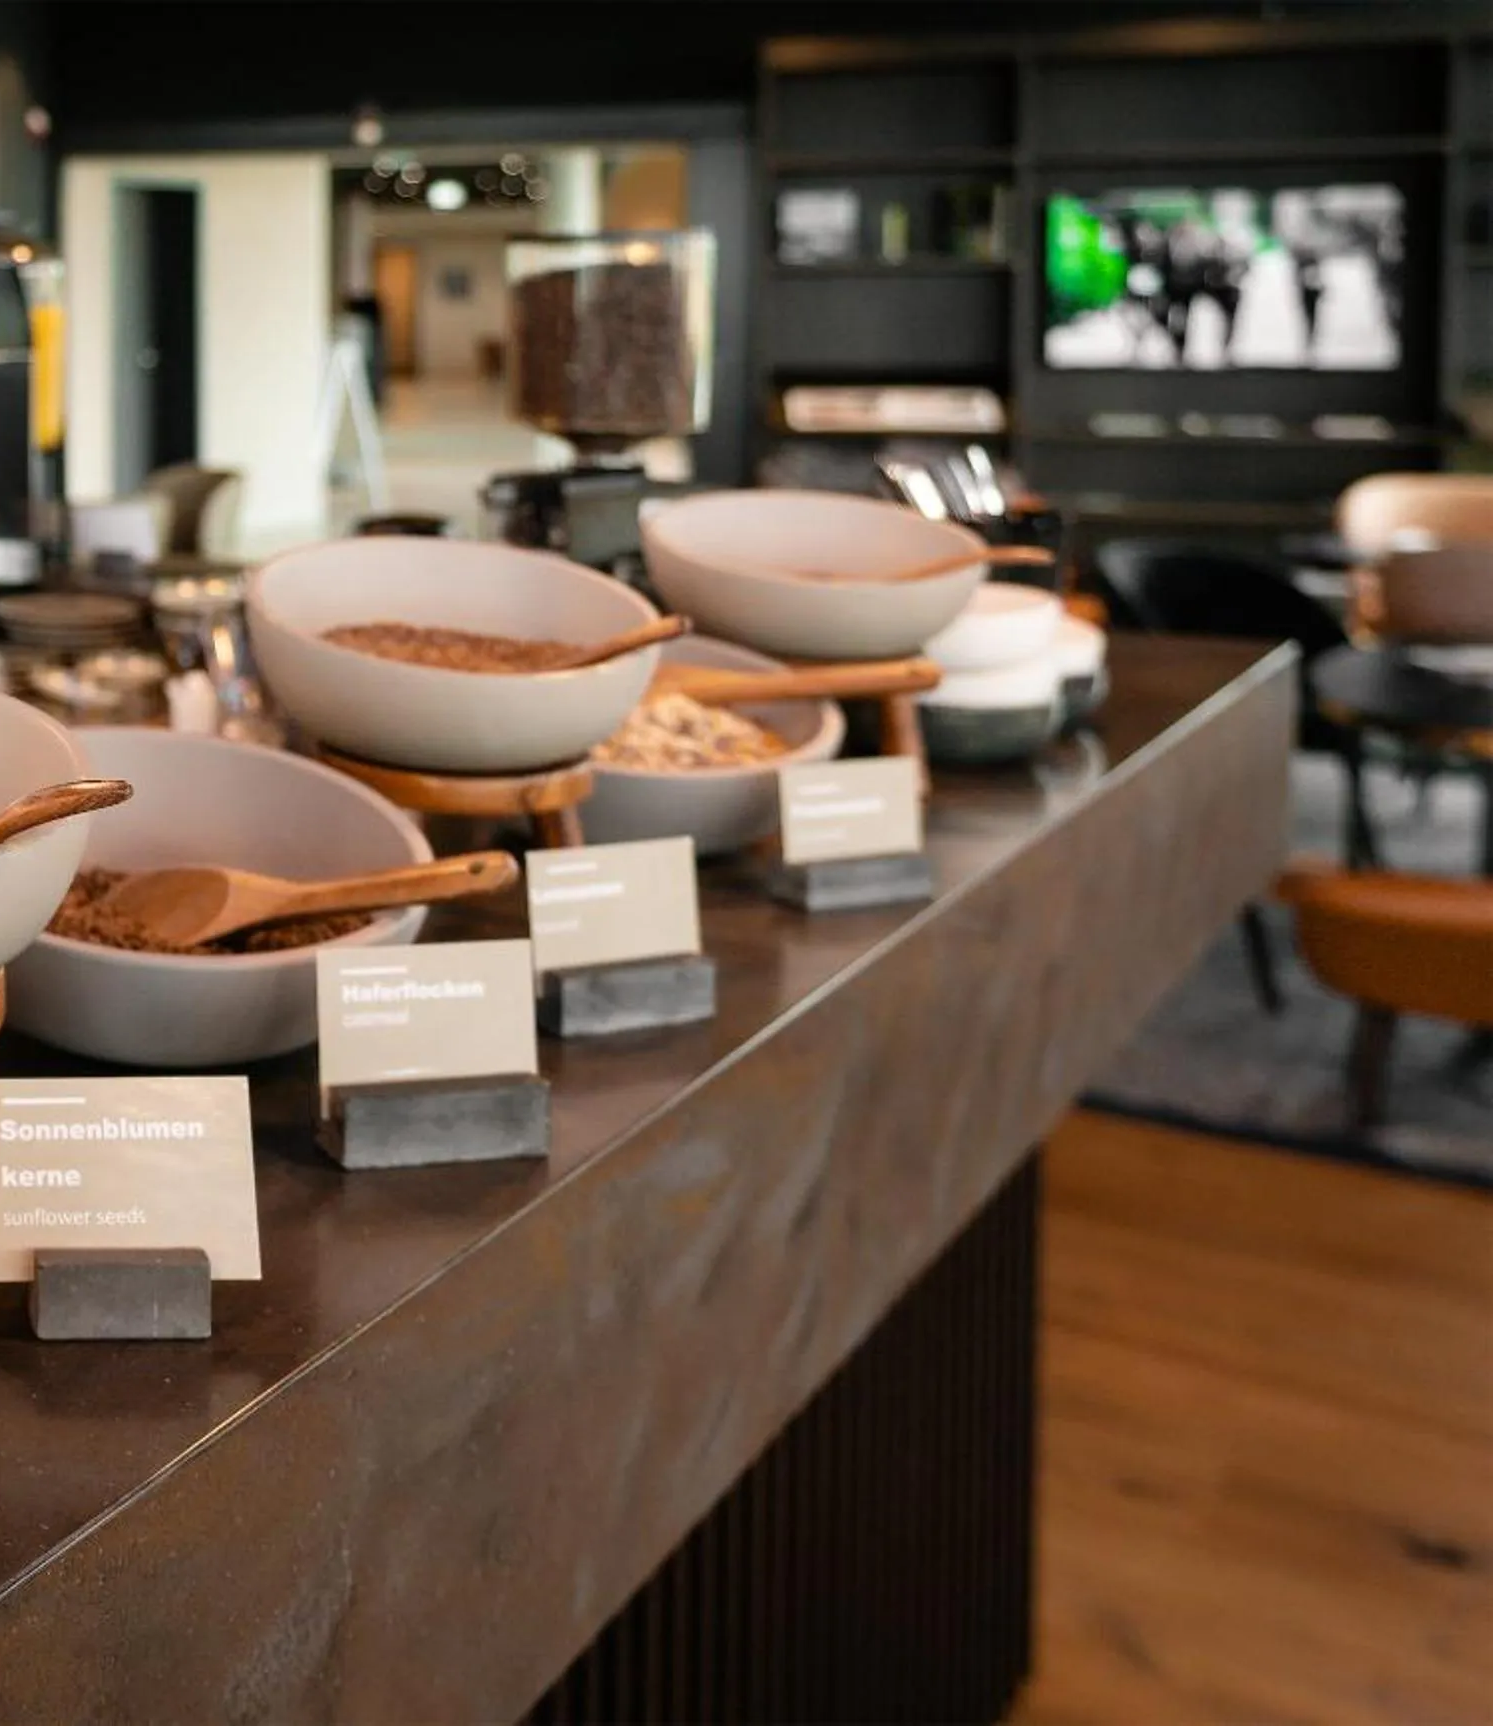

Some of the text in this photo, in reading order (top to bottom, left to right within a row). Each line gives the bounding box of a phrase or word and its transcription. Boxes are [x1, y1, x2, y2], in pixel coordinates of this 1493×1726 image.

[0, 1117, 204, 1142] Sonnenblumen
[1, 1165, 82, 1188] kerne
[3, 1204, 147, 1227] sunflower seeds
